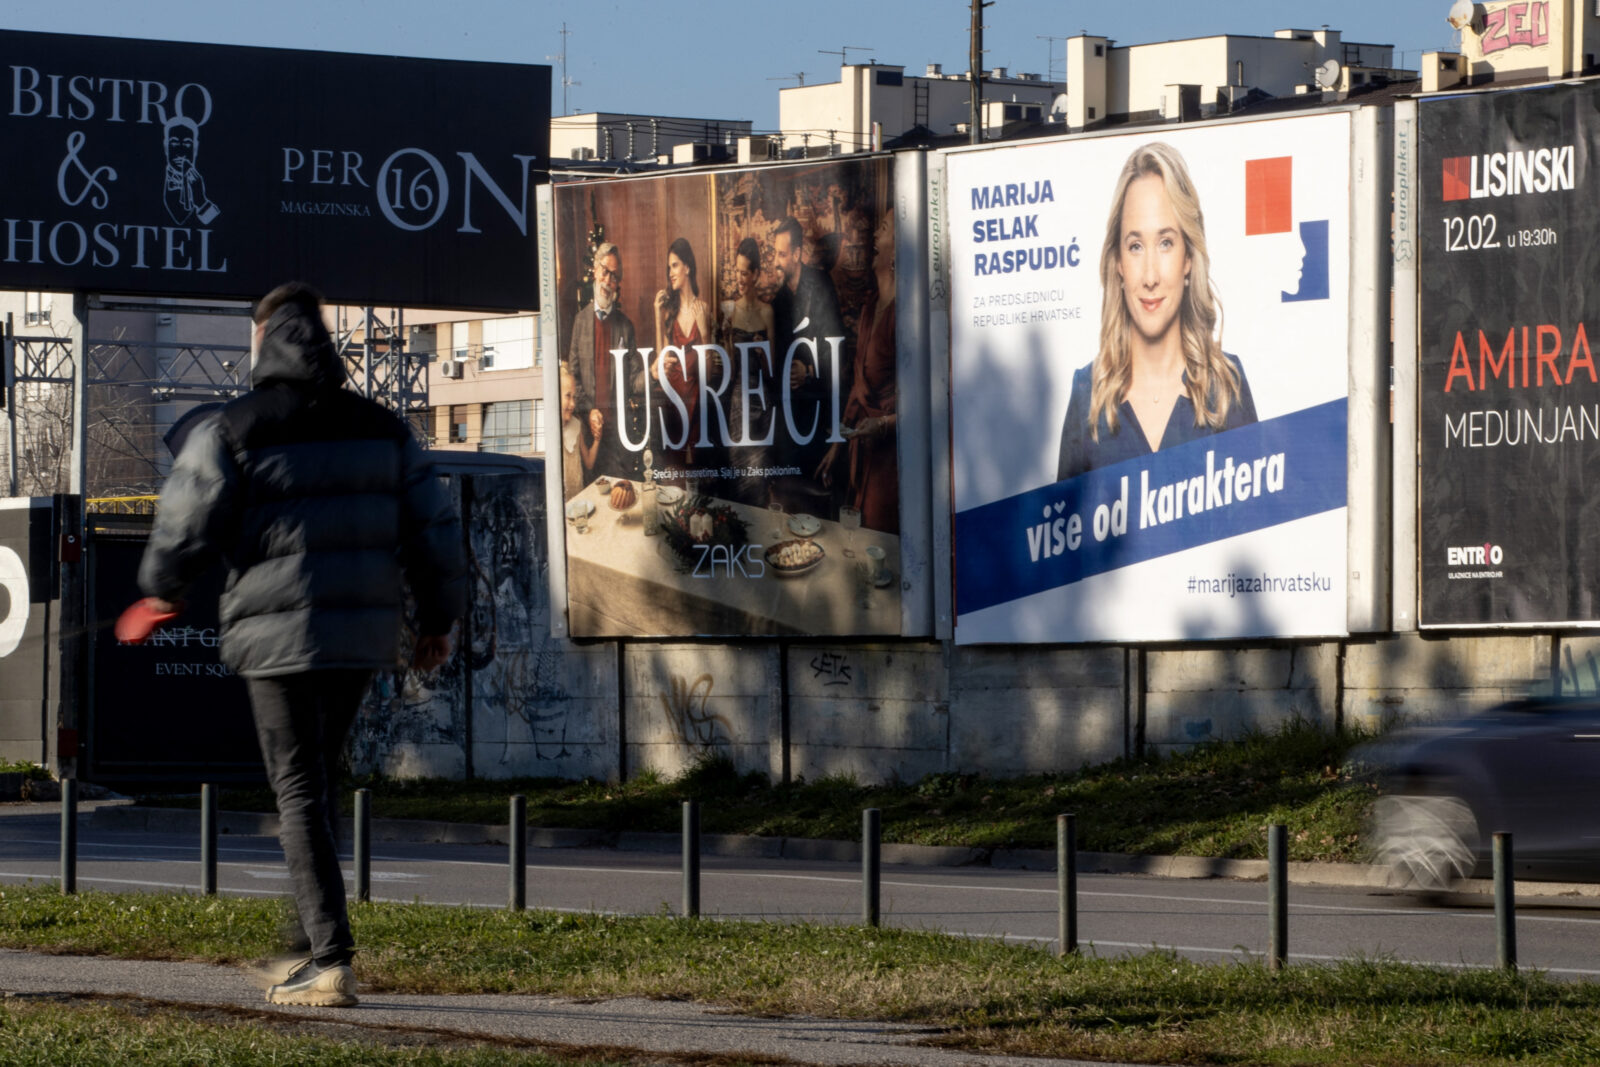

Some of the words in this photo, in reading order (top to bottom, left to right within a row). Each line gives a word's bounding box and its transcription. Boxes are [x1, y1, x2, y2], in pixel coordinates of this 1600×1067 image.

[8, 65, 213, 127] BISTRO
[1396, 131, 1409, 232] europlakat
[1470, 145, 1575, 199] LISINSKI
[280, 200, 371, 217] MAGAZINSKA
[971, 179, 1055, 211] MARIJA
[930, 180, 941, 272] europlakat
[972, 214, 1040, 243] SELAK
[1442, 213, 1500, 252] 12.02.
[1507, 234, 1516, 248] u
[1518, 227, 1557, 247] 19:30h
[2, 218, 228, 274] HOSTEL
[973, 236, 1081, 277] RASPUDIĆ
[972, 311, 1028, 329] REPUBLIKE
[1029, 306, 1082, 323] HRVATSKE
[973, 296, 986, 309] ZA
[988, 289, 1065, 306] PREDSJEDNICU
[1444, 322, 1598, 393] AMIRA
[609, 316, 847, 453] USREĆI
[1445, 403, 1599, 449] MEDUNJAN
[747, 466, 764, 477] Zaks
[1026, 500, 1082, 563] više
[1092, 475, 1129, 542] od
[1139, 450, 1285, 530] karaktera
[692, 544, 765, 579] ZAKS
[1447, 542, 1504, 566] ENTRIO
[1187, 572, 1331, 598] #marijazahrvatsku
[155, 663, 203, 676] EVENT
[205, 663, 235, 678] SQU
